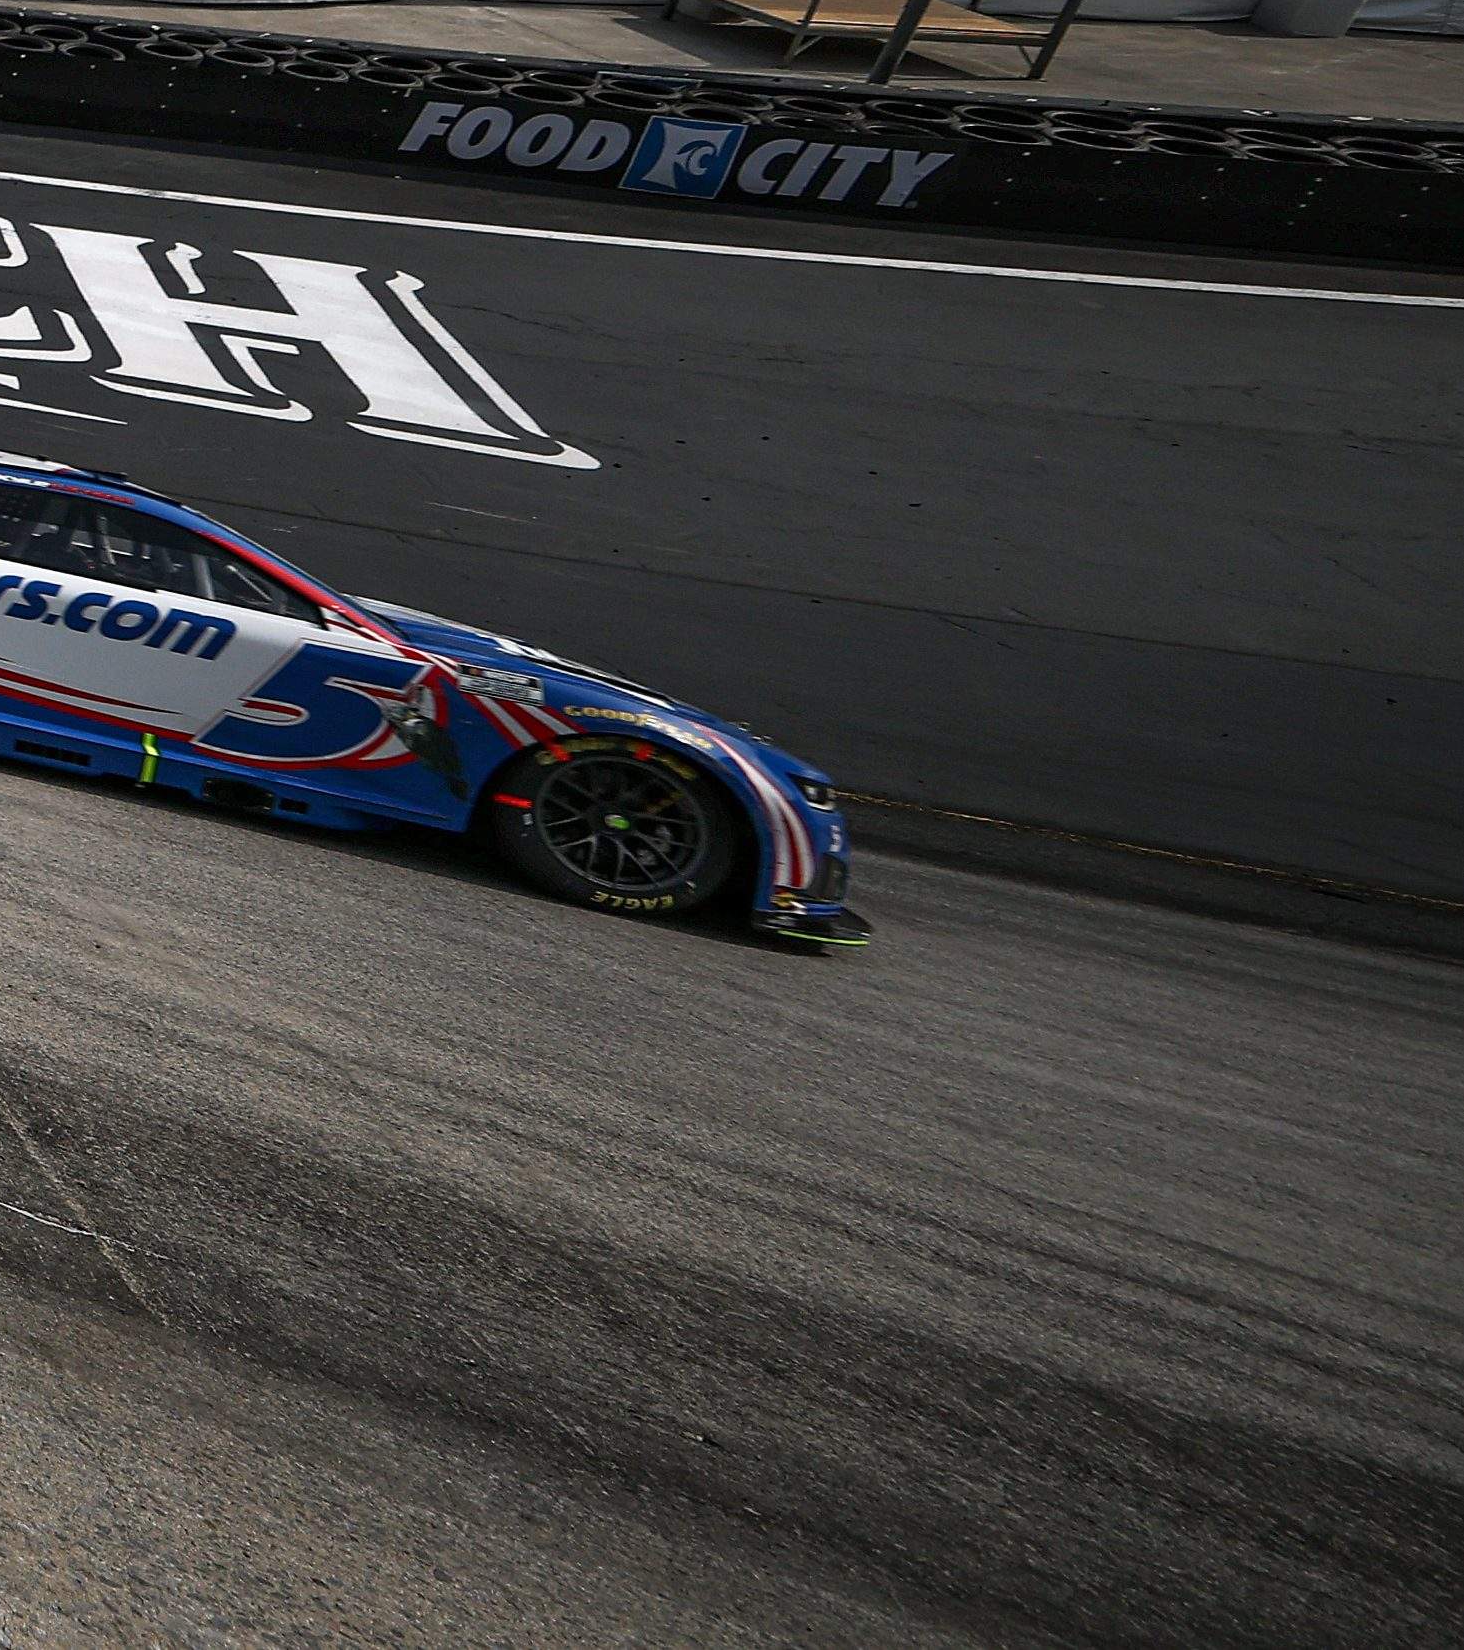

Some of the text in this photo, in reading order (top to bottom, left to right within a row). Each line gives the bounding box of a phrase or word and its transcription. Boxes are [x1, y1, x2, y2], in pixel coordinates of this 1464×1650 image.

[398, 101, 955, 208] FOOD CITY
[192, 636, 433, 769] 5
[562, 702, 714, 752] GOODYEAR
[591, 889, 675, 912] EAGLE
